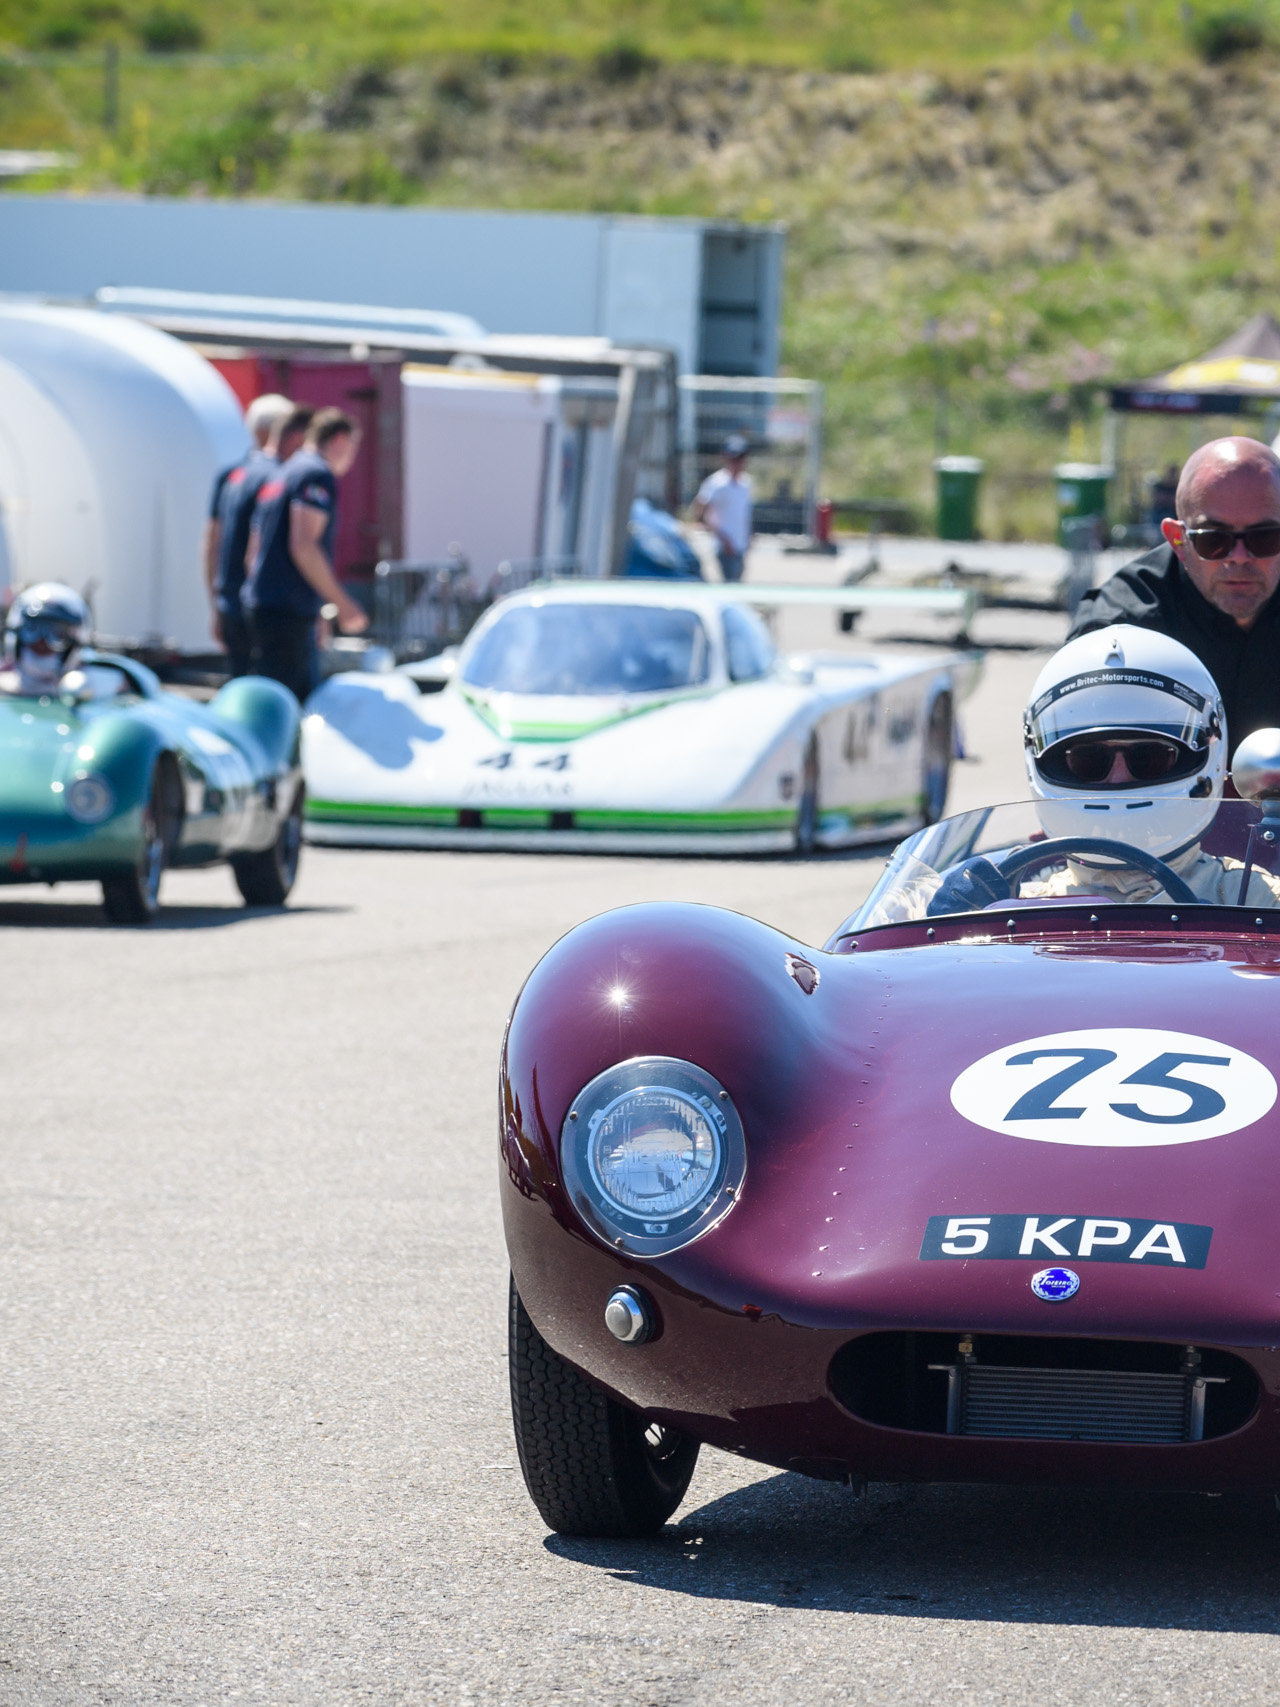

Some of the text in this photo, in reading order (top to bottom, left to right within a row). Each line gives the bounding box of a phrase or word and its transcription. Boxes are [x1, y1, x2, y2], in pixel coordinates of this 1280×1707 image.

[1060, 673, 1164, 695] www.Britec-Motorsports.com
[1003, 1048, 1232, 1124] 25
[941, 1217, 1187, 1263] 5 KPA
